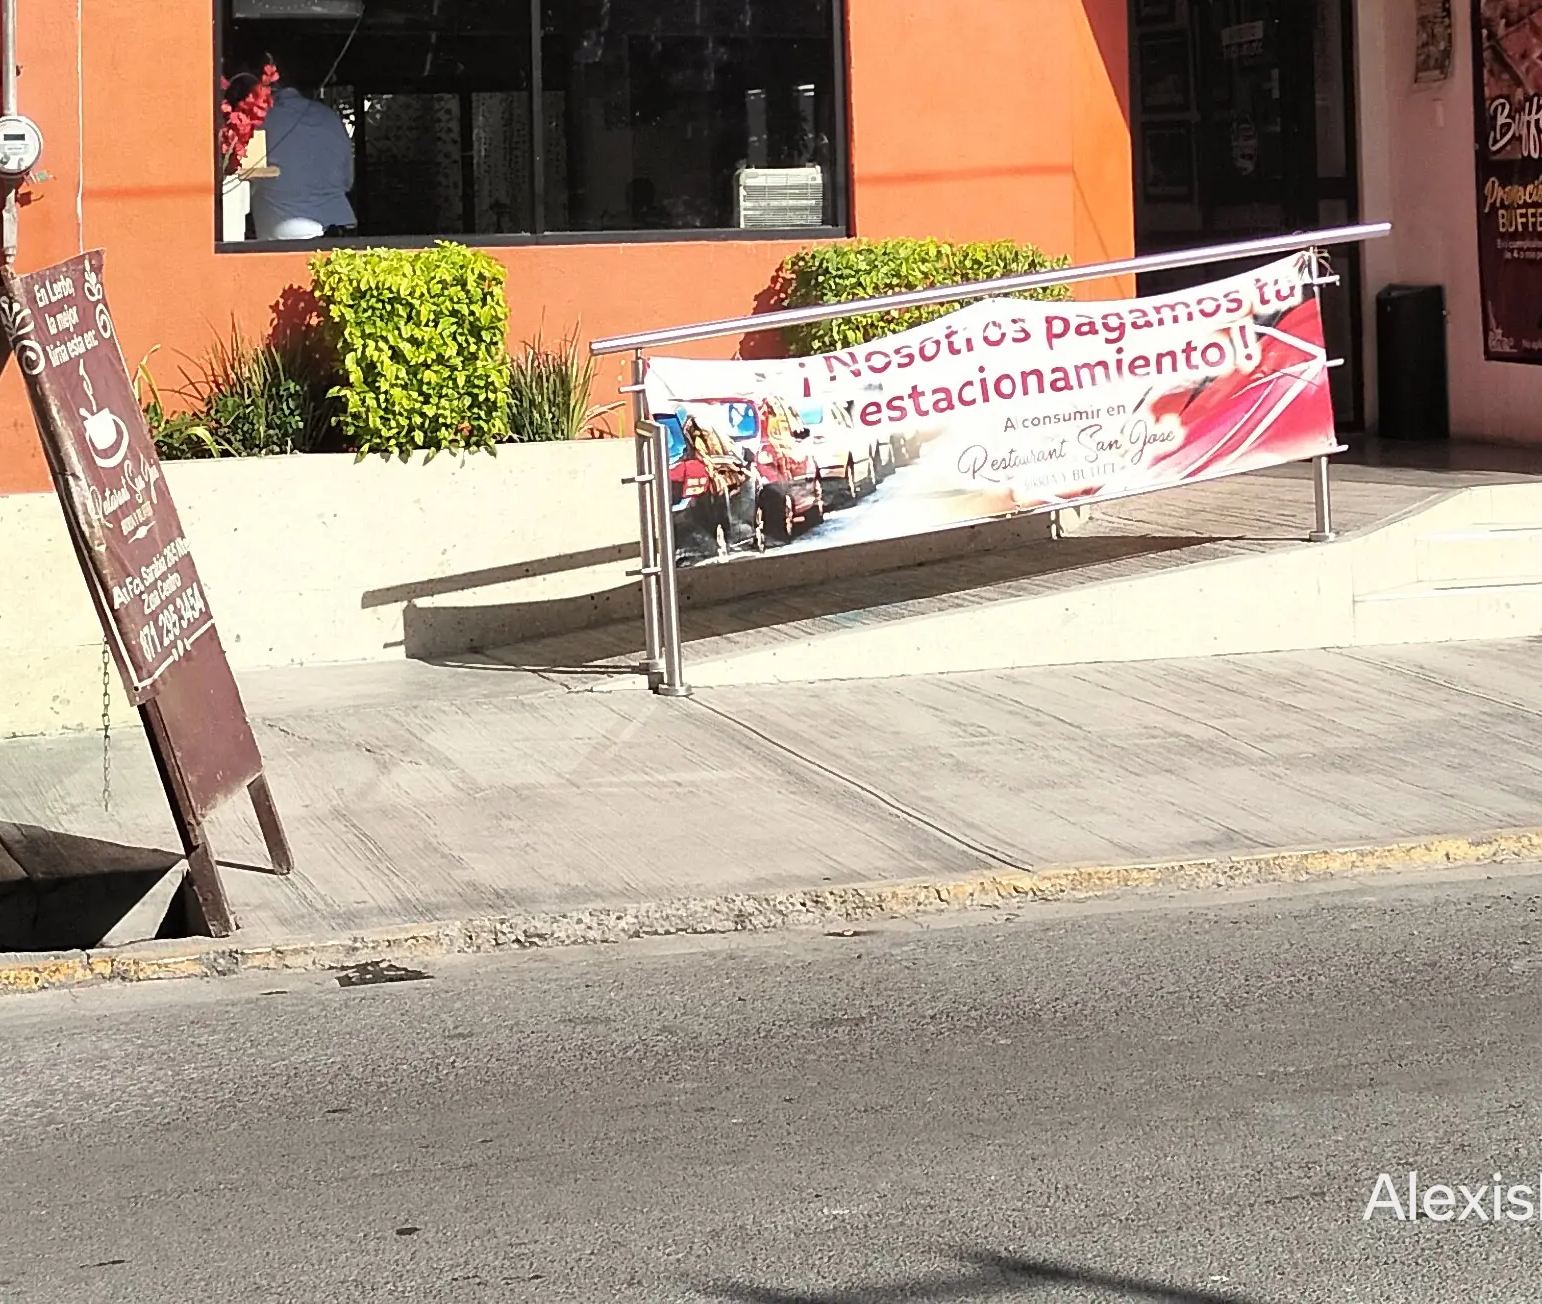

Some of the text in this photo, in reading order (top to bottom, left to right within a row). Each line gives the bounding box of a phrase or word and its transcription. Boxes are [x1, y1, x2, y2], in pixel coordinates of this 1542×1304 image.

[1045, 290, 1244, 351] pagamos
[1258, 274, 1296, 307] tu
[1022, 407, 1101, 429] consumir
[1107, 404, 1126, 416] en
[957, 439, 1067, 483] Restaurant
[1077, 423, 1122, 463] San
